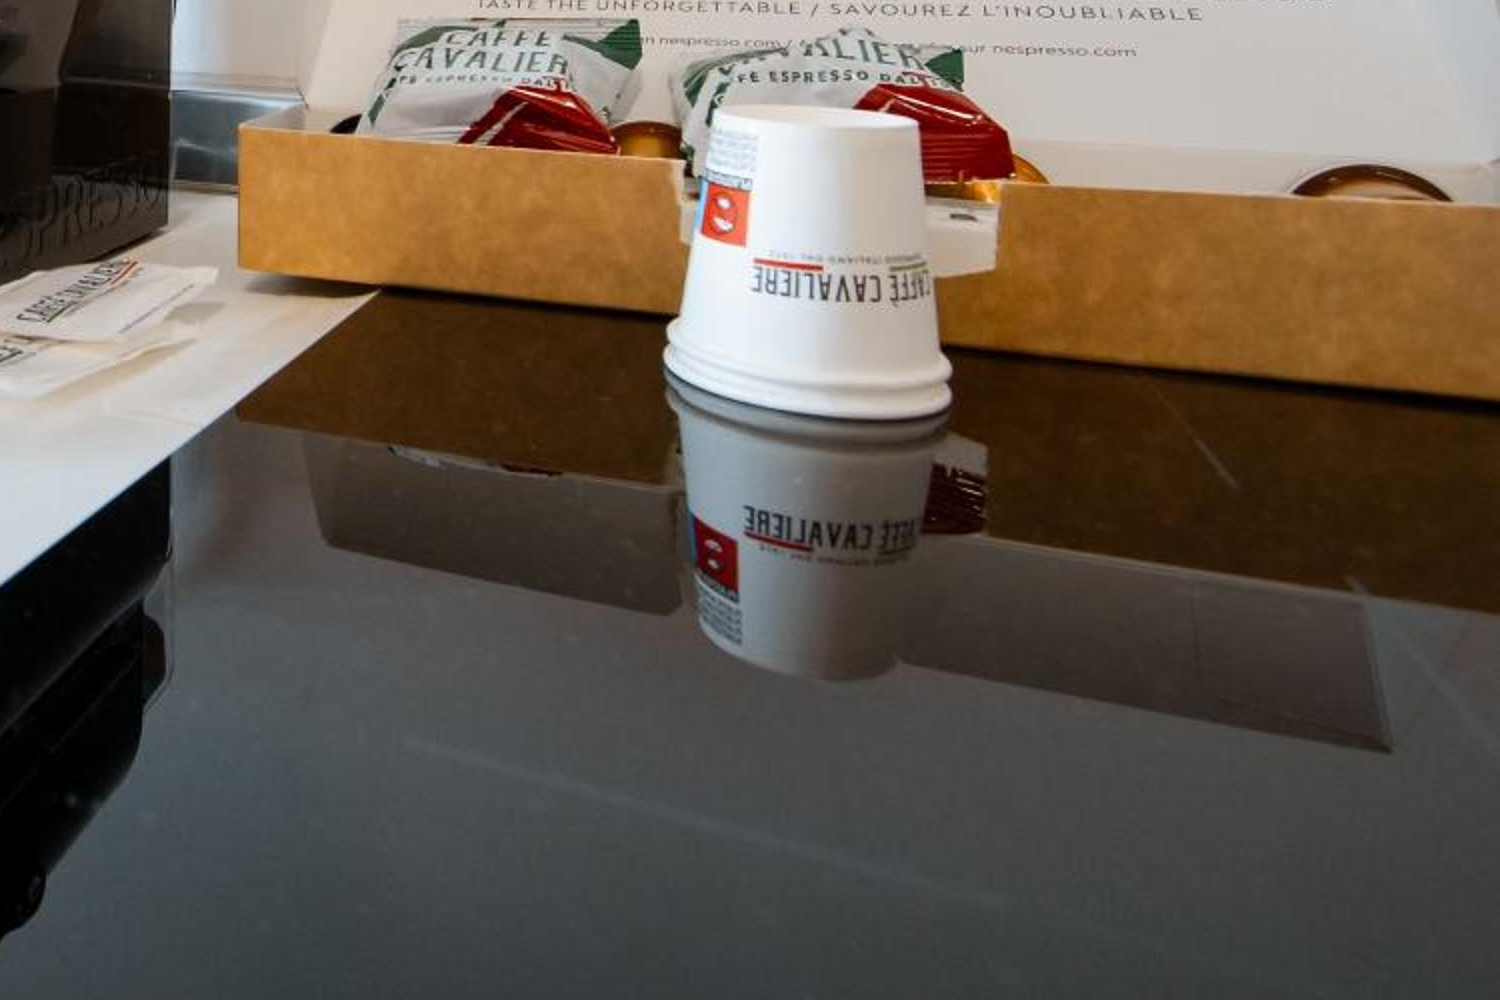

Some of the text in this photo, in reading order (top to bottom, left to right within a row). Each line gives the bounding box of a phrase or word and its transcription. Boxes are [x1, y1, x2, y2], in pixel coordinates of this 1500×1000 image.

[597, 0, 801, 15] UNFORGETTABLE
[830, 3, 971, 18] SAVOUREZ
[983, 3, 1204, 22] L'INOUBLIABLE
[395, 47, 568, 75] CAVALIER
[993, 45, 1138, 58] nespresso.com
[769, 69, 869, 84] ESPRESSO
[751, 266, 882, 303] CAVALIERE
